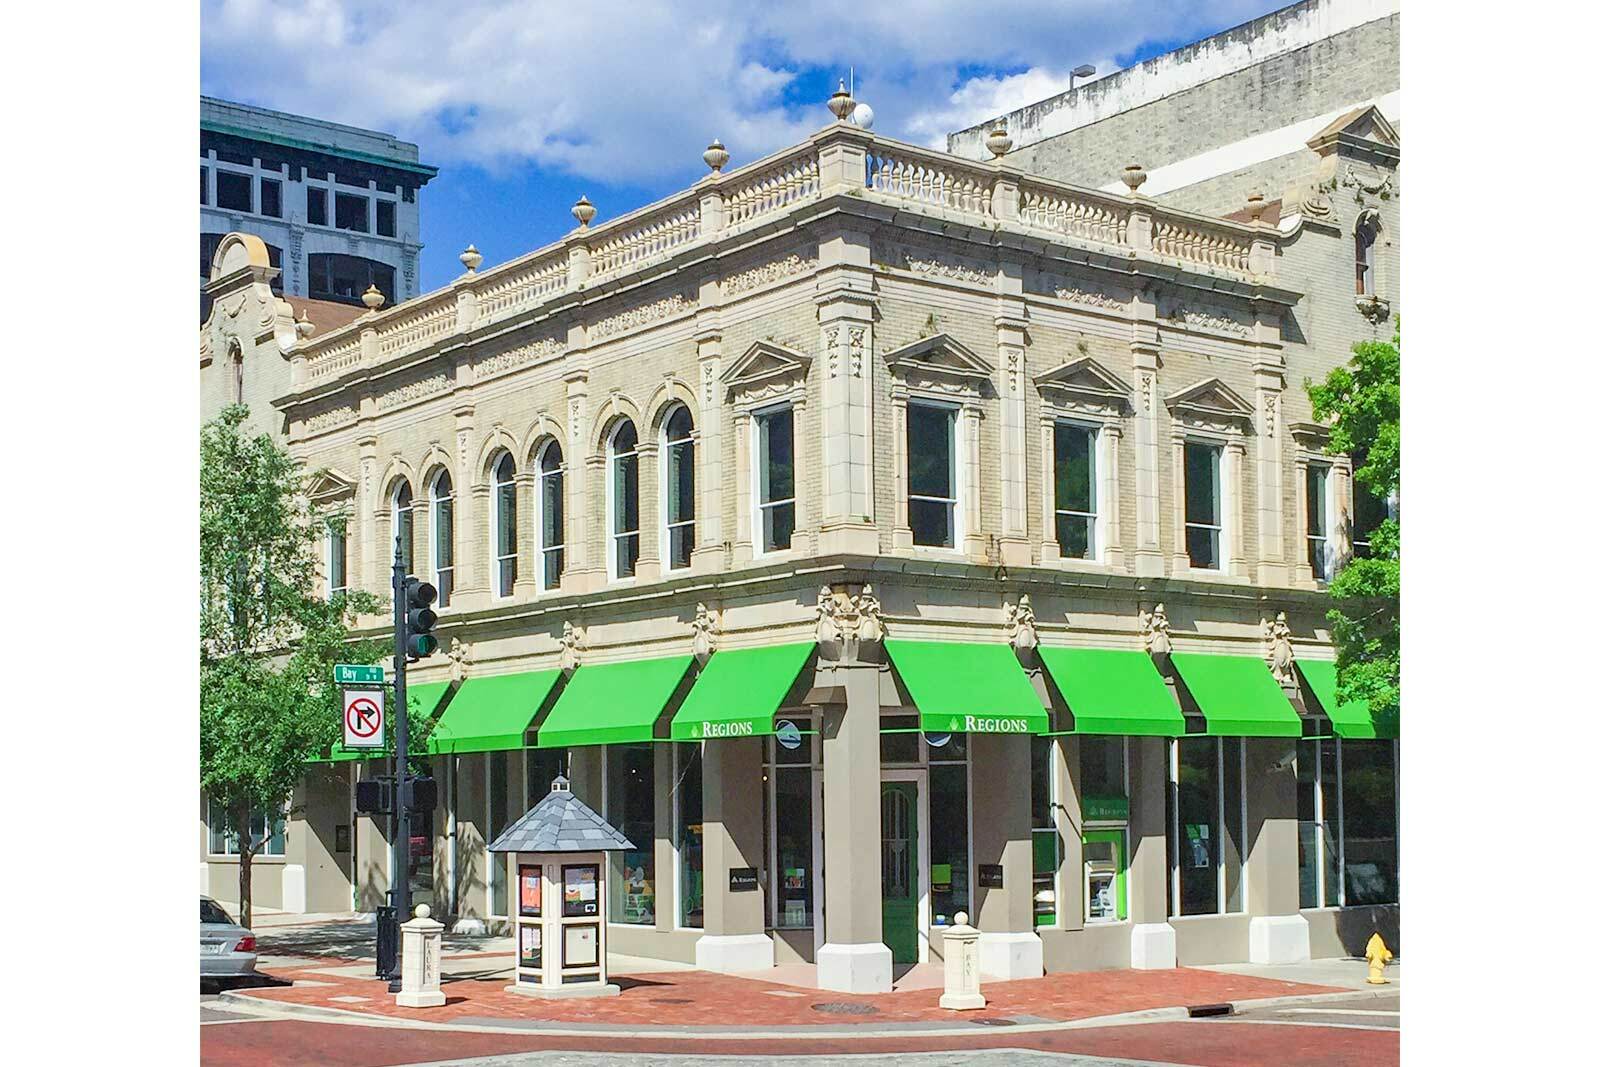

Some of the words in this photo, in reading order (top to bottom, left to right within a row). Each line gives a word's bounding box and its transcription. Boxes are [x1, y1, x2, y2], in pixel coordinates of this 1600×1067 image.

[342, 667, 357, 681] Bay
[702, 721, 753, 738] REGIONS
[964, 715, 1028, 732] REGIONS
